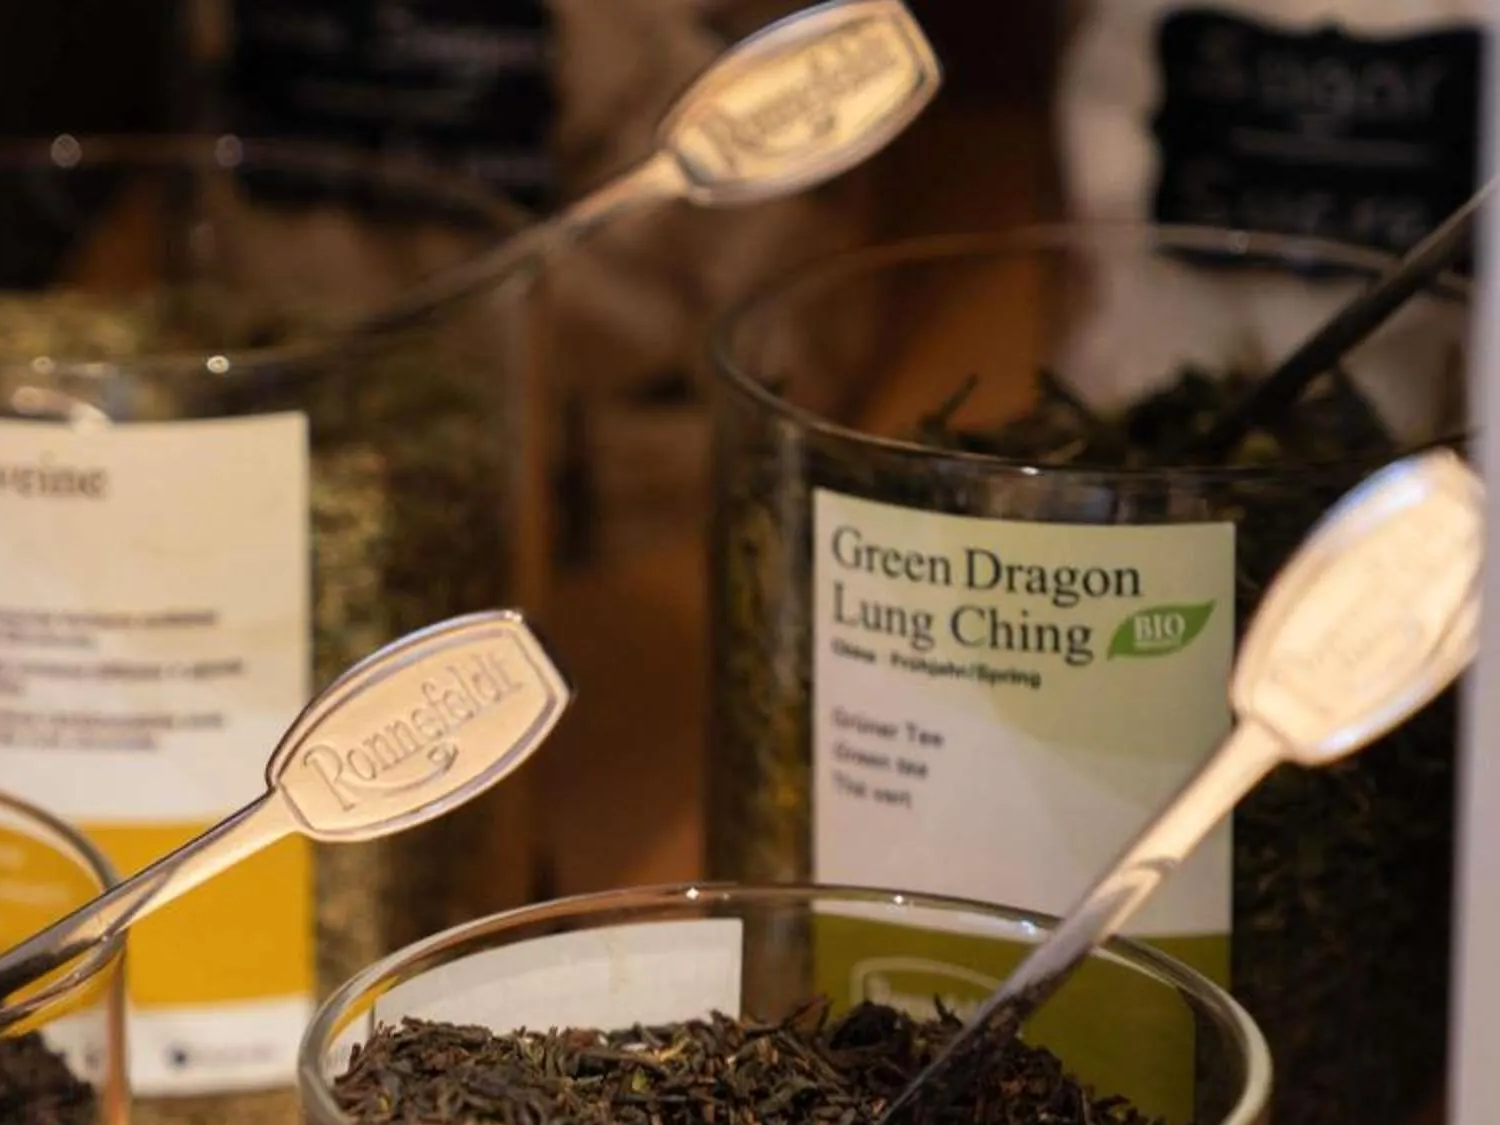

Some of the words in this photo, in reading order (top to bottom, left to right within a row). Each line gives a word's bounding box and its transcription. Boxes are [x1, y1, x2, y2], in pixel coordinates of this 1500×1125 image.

[832, 526, 952, 587] Green
[963, 548, 1142, 608] Dragon
[833, 582, 935, 651] Lung
[950, 604, 1095, 666] Ching
[1133, 612, 1186, 641] BIO
[303, 653, 523, 811] Ronnefeldt
